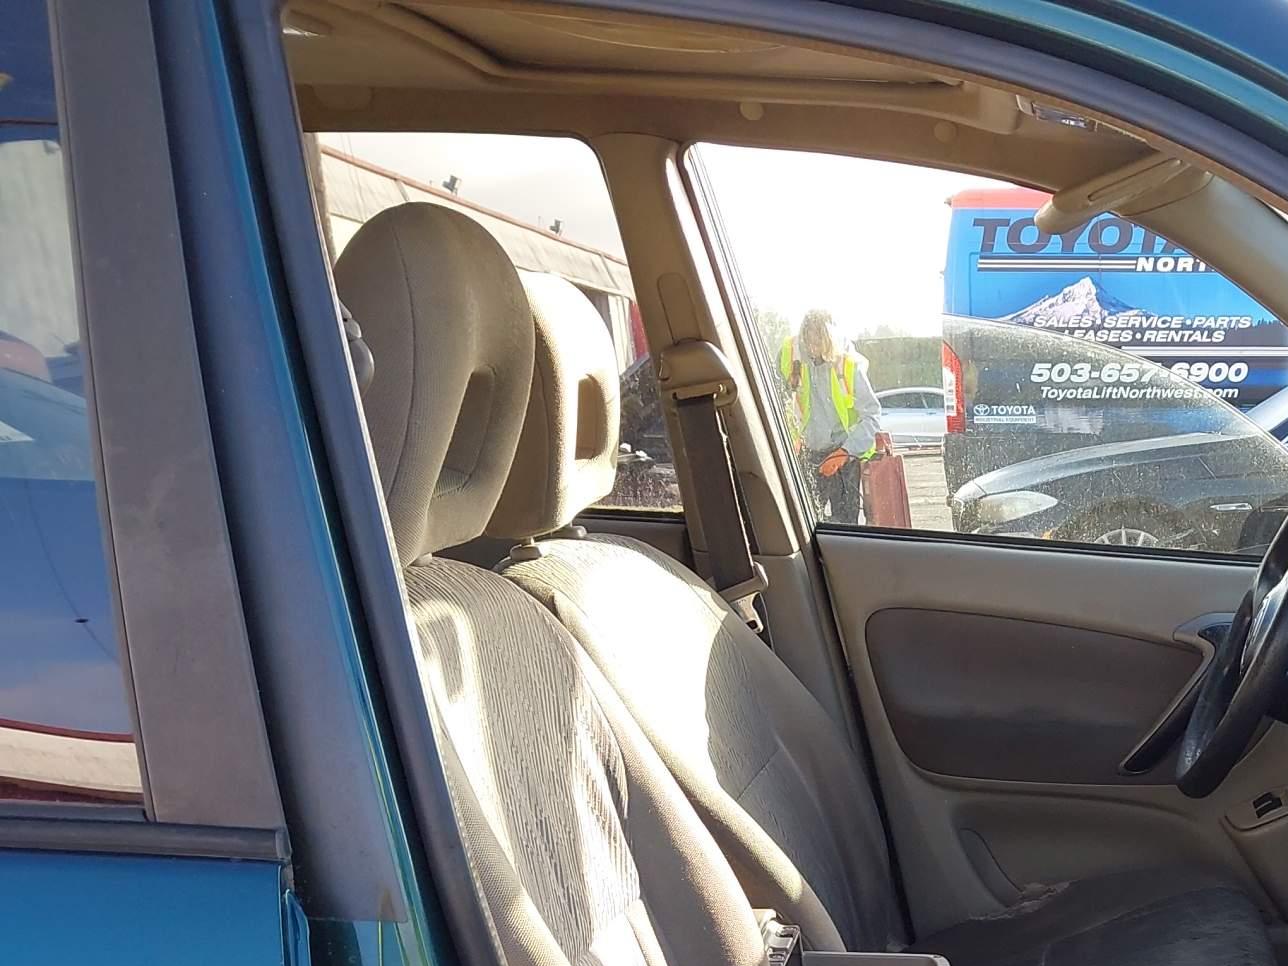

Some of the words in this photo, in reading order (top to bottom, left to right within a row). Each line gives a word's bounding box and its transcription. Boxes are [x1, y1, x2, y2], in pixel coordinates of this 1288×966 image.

[1034, 316, 1092, 327] SALES
[1104, 316, 1184, 328] SERVICE
[1193, 316, 1251, 328] PARTS
[1063, 330, 1132, 342] LEASES
[1143, 331, 1225, 342] RENTALS
[1030, 362, 1249, 383] 503-657-6900
[991, 405, 1036, 415] TOYOTA
